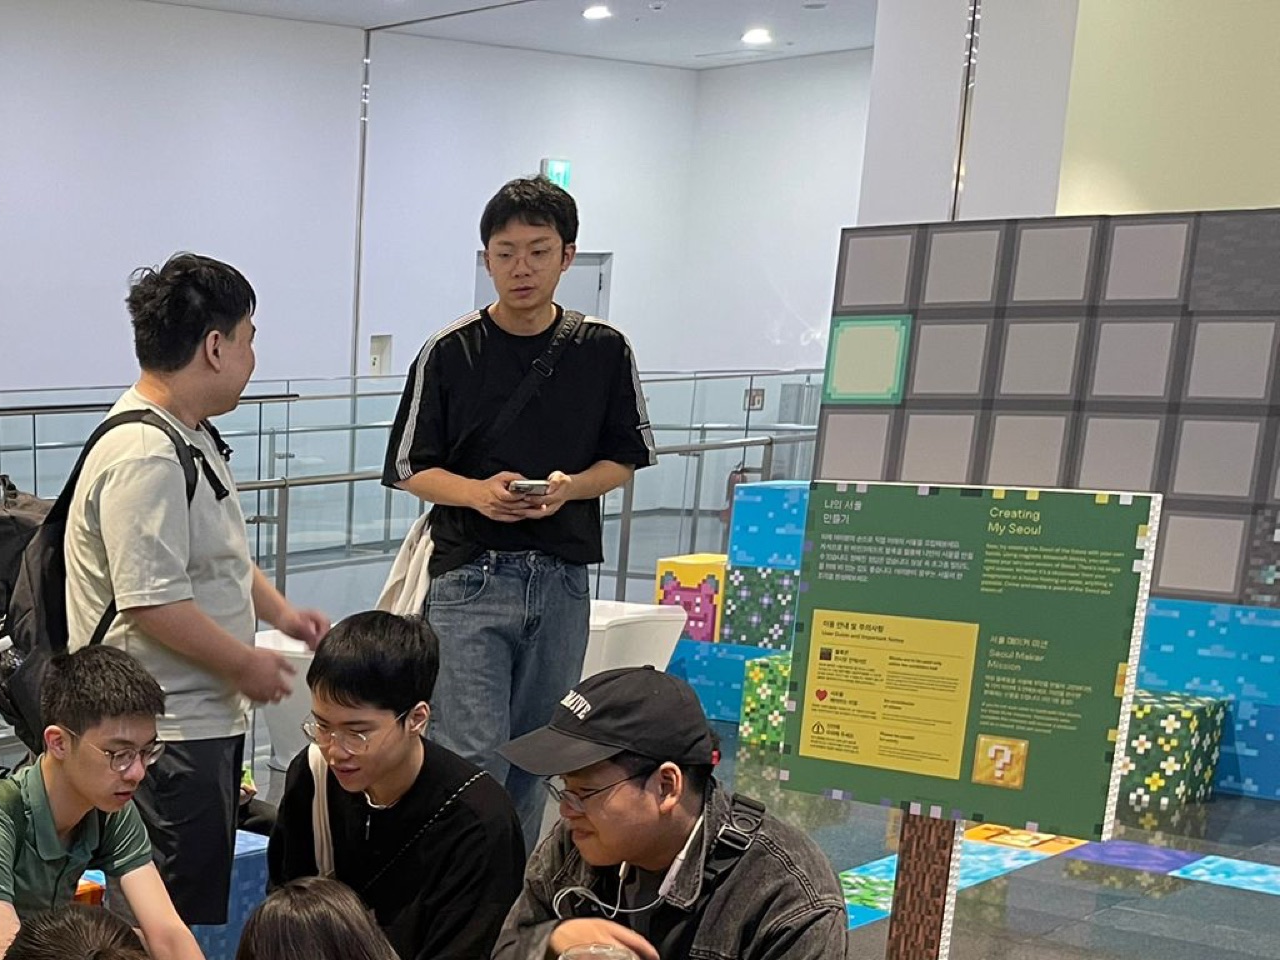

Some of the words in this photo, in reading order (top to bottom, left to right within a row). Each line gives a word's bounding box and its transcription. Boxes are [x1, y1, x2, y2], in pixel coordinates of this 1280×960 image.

[824, 500, 841, 509] 나의
[844, 501, 861, 510] 서울
[824, 514, 849, 524] 만들기
[990, 507, 1040, 521] Creating
[988, 522, 1005, 535] My
[1008, 523, 1041, 535] Seoul
[990, 636, 1004, 644] 서울
[989, 649, 1014, 659] Seoul
[1015, 651, 1044, 661] Maker
[987, 660, 1021, 671] Mission
